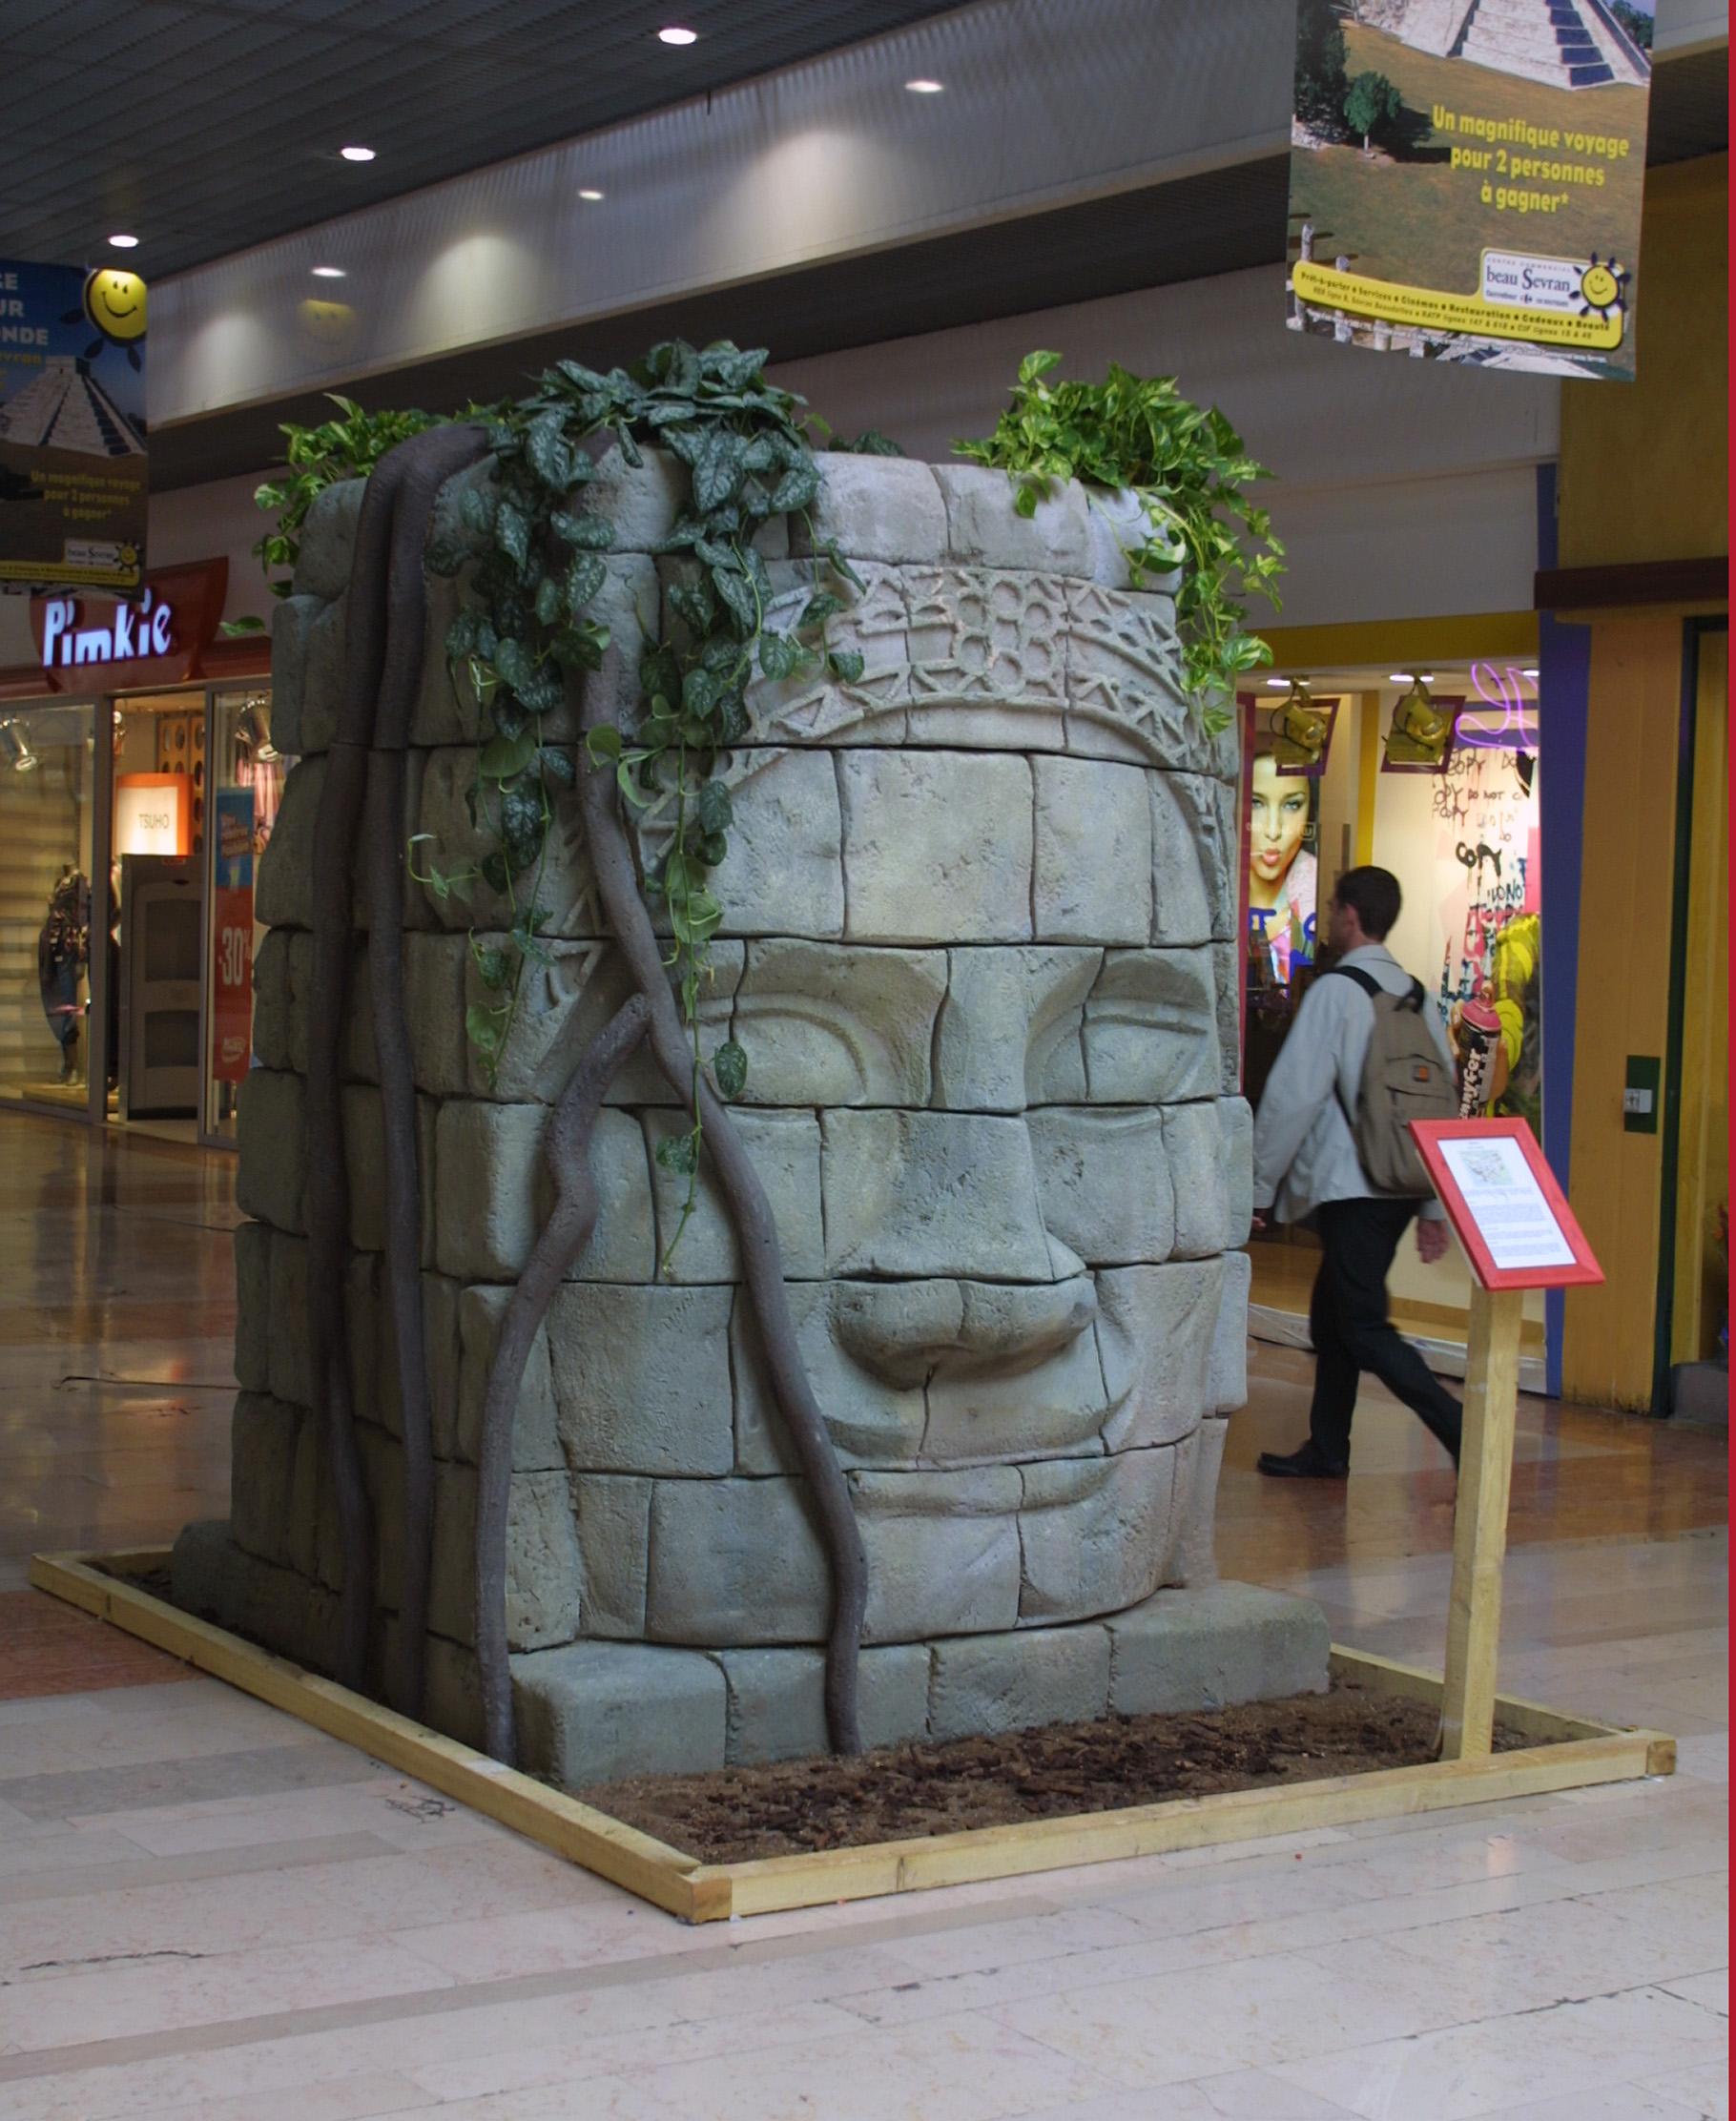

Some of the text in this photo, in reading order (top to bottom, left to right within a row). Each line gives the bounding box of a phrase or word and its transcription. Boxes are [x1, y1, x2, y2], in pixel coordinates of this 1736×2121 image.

[1433, 105, 1630, 160] Un magnifique voyage
[1451, 146, 1605, 187] pour 2 personnes
[1480, 178, 1492, 204] à
[1486, 266, 1570, 292] beau Sevran
[1358, 287, 1392, 301] Services
[1449, 303, 1510, 320] Restauration
[1522, 314, 1563, 327] Cadeaux
[0, 326, 49, 346] NDE
[43, 587, 172, 668] Pimkie
